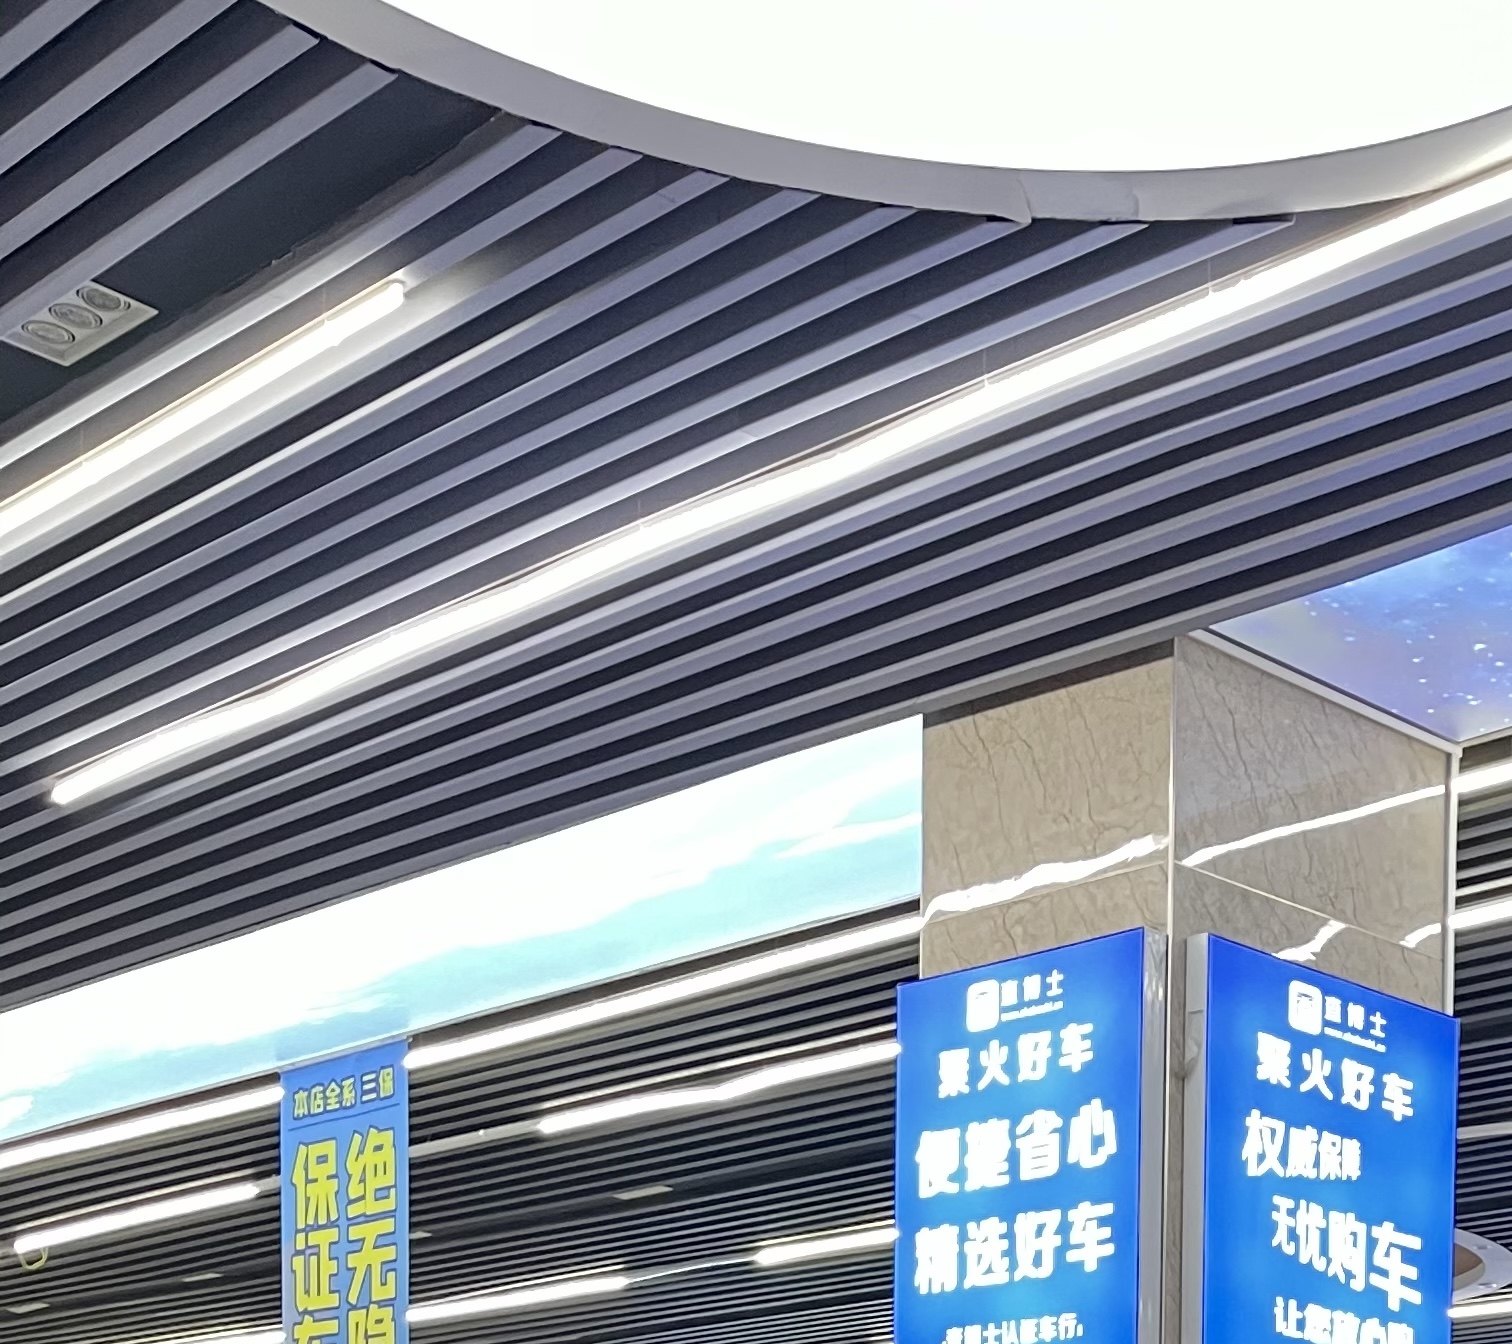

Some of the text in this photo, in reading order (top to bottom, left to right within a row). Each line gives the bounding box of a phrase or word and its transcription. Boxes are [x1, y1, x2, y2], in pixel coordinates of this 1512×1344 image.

[292, 1078, 356, 1119] 本店全系
[1241, 1108, 1362, 1181] 权威保障
[915, 1097, 1118, 1199] 便捷省心
[914, 1200, 1116, 1295] 精选好车
[1271, 1194, 1422, 1313] 无忧购车
